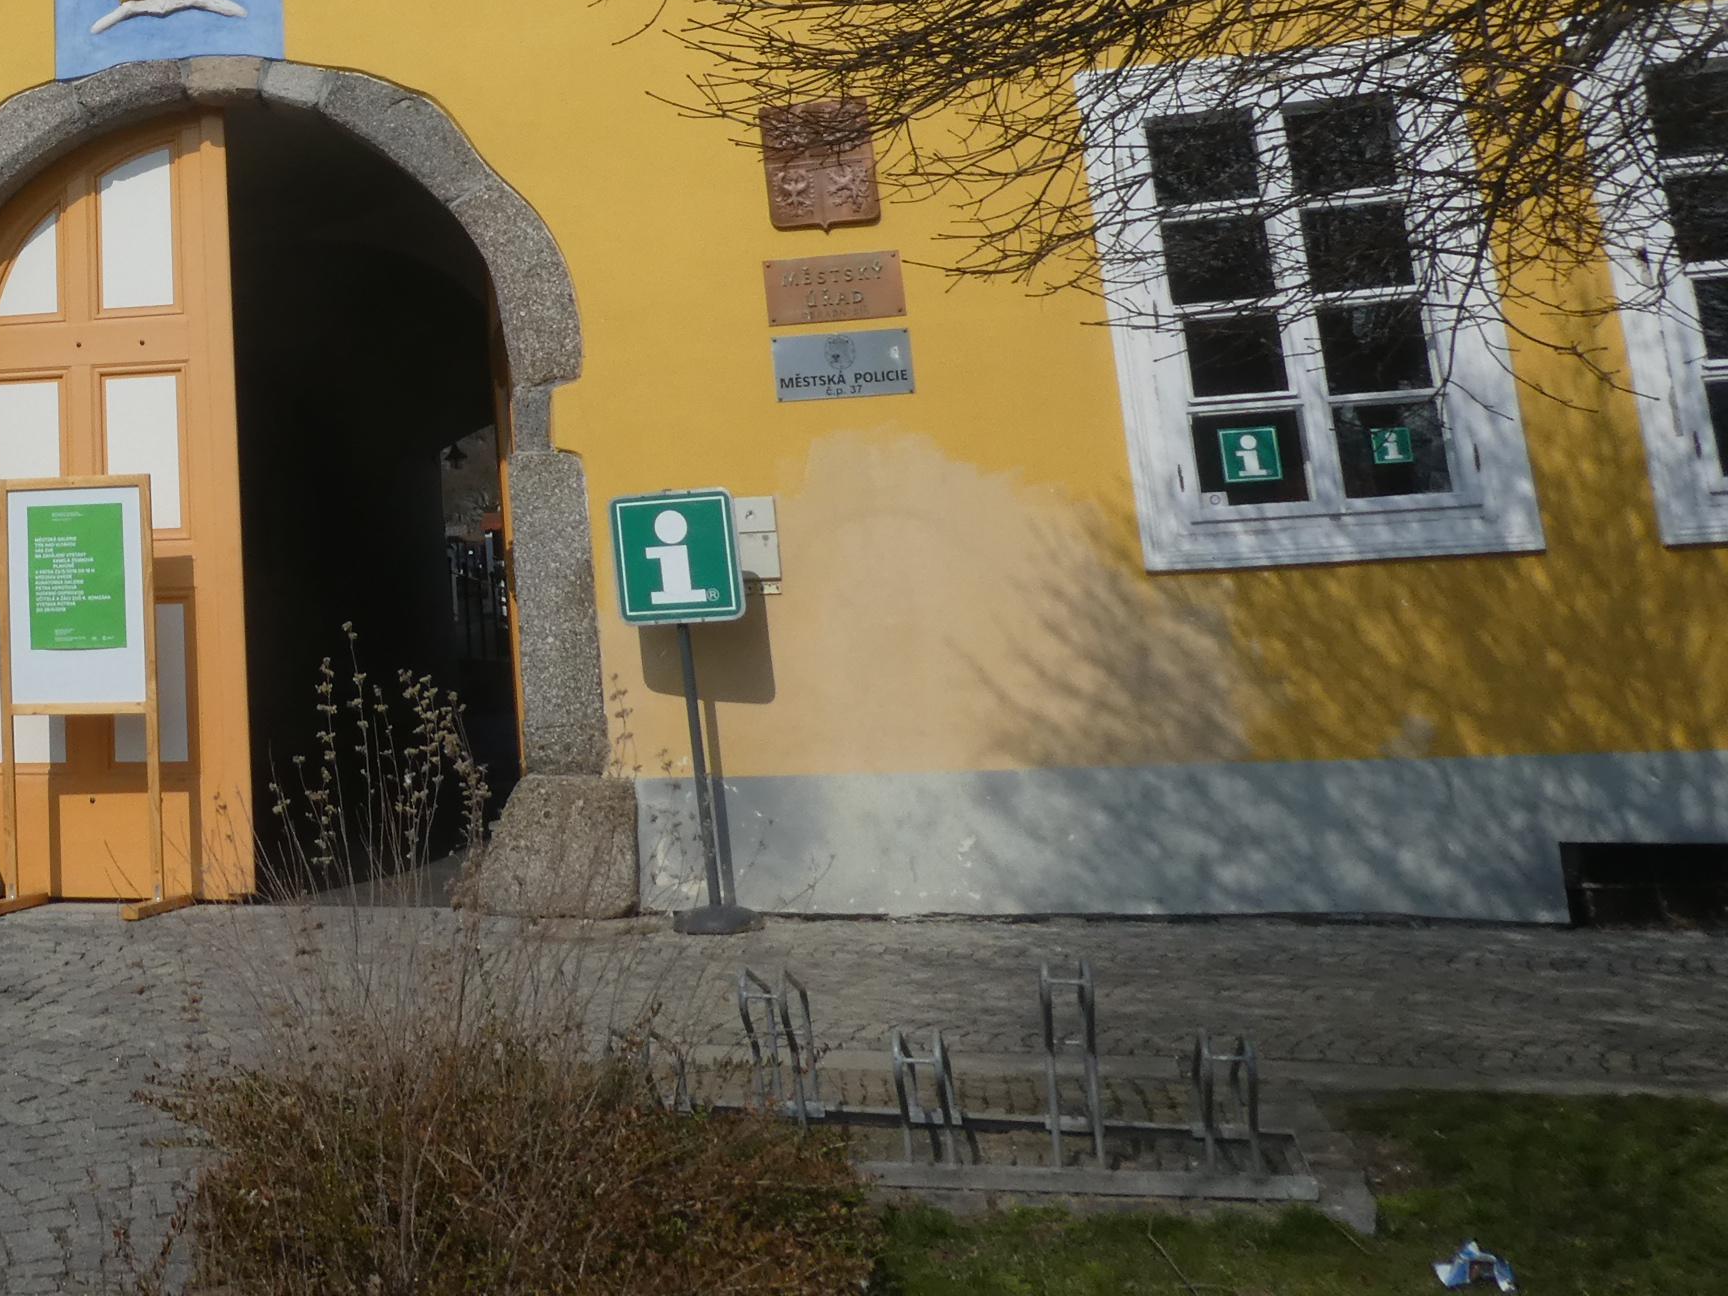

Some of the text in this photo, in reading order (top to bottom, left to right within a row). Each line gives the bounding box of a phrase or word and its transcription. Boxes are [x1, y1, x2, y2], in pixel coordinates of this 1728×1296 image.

[783, 259, 883, 287] MĚSTSKÝ
[804, 287, 864, 308] ÚŘAD
[780, 369, 909, 389] MĚSTSKÁ POLICIE
[850, 385, 863, 394] 37
